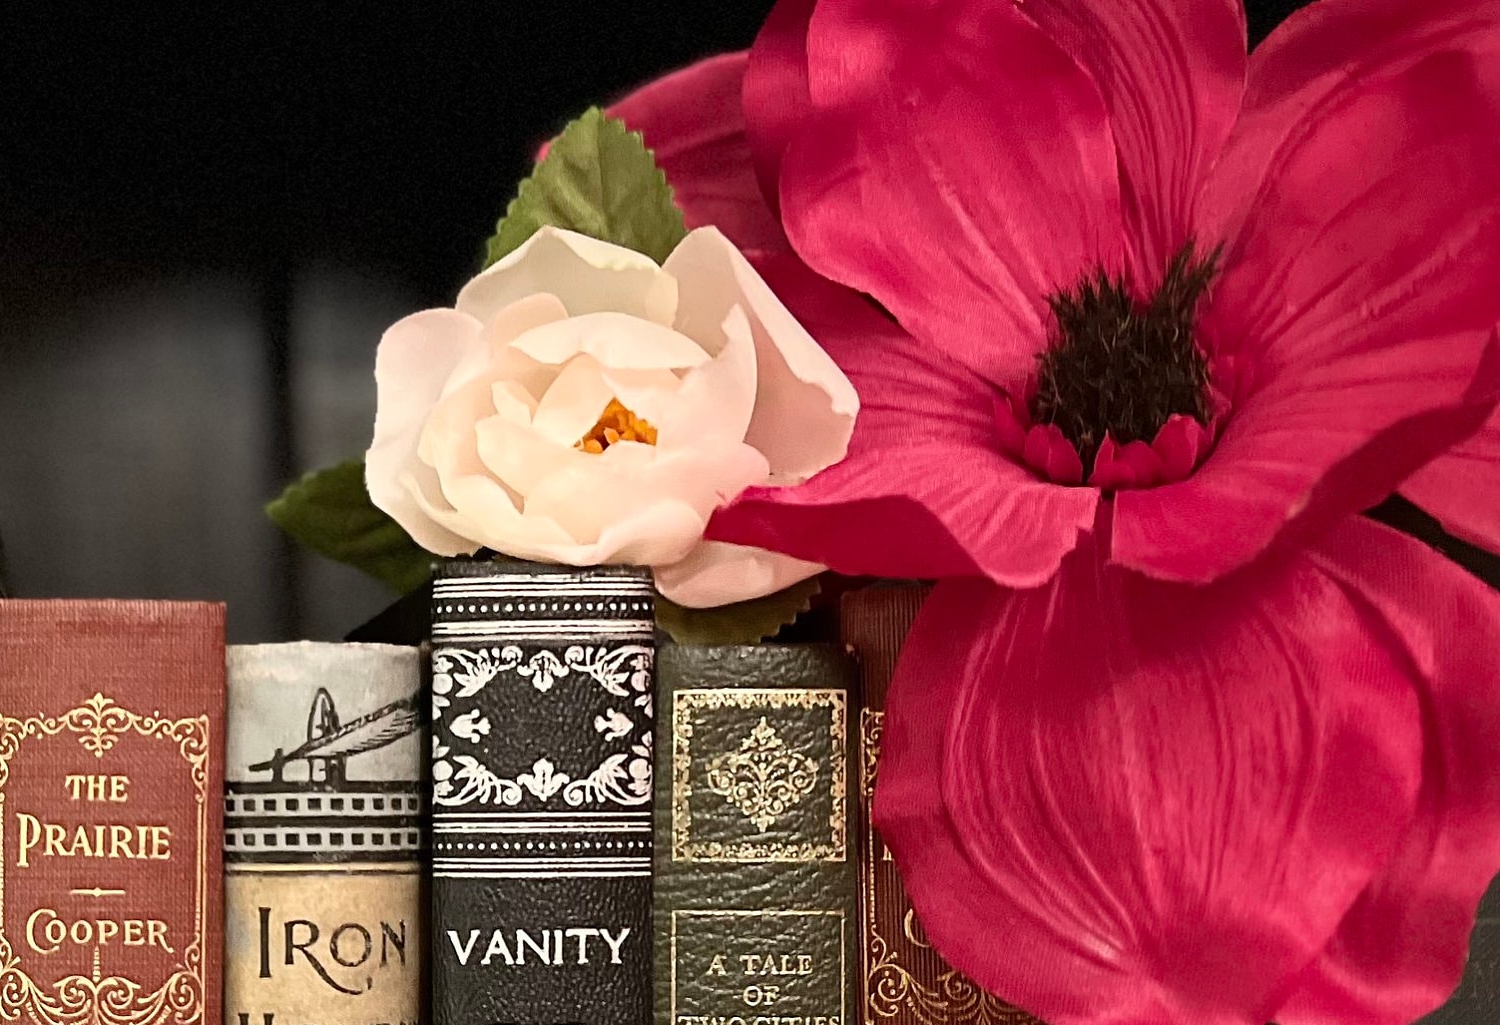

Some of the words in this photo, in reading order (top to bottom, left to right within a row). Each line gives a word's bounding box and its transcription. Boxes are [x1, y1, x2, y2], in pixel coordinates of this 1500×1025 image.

[65, 775, 129, 802] THE
[16, 813, 172, 868] PRAIRIE
[26, 908, 174, 954] COOPER
[447, 928, 631, 967] VANITY
[258, 907, 406, 996] IRON
[705, 954, 727, 976] A
[739, 954, 813, 976] TALE
[743, 985, 781, 1007] OF
